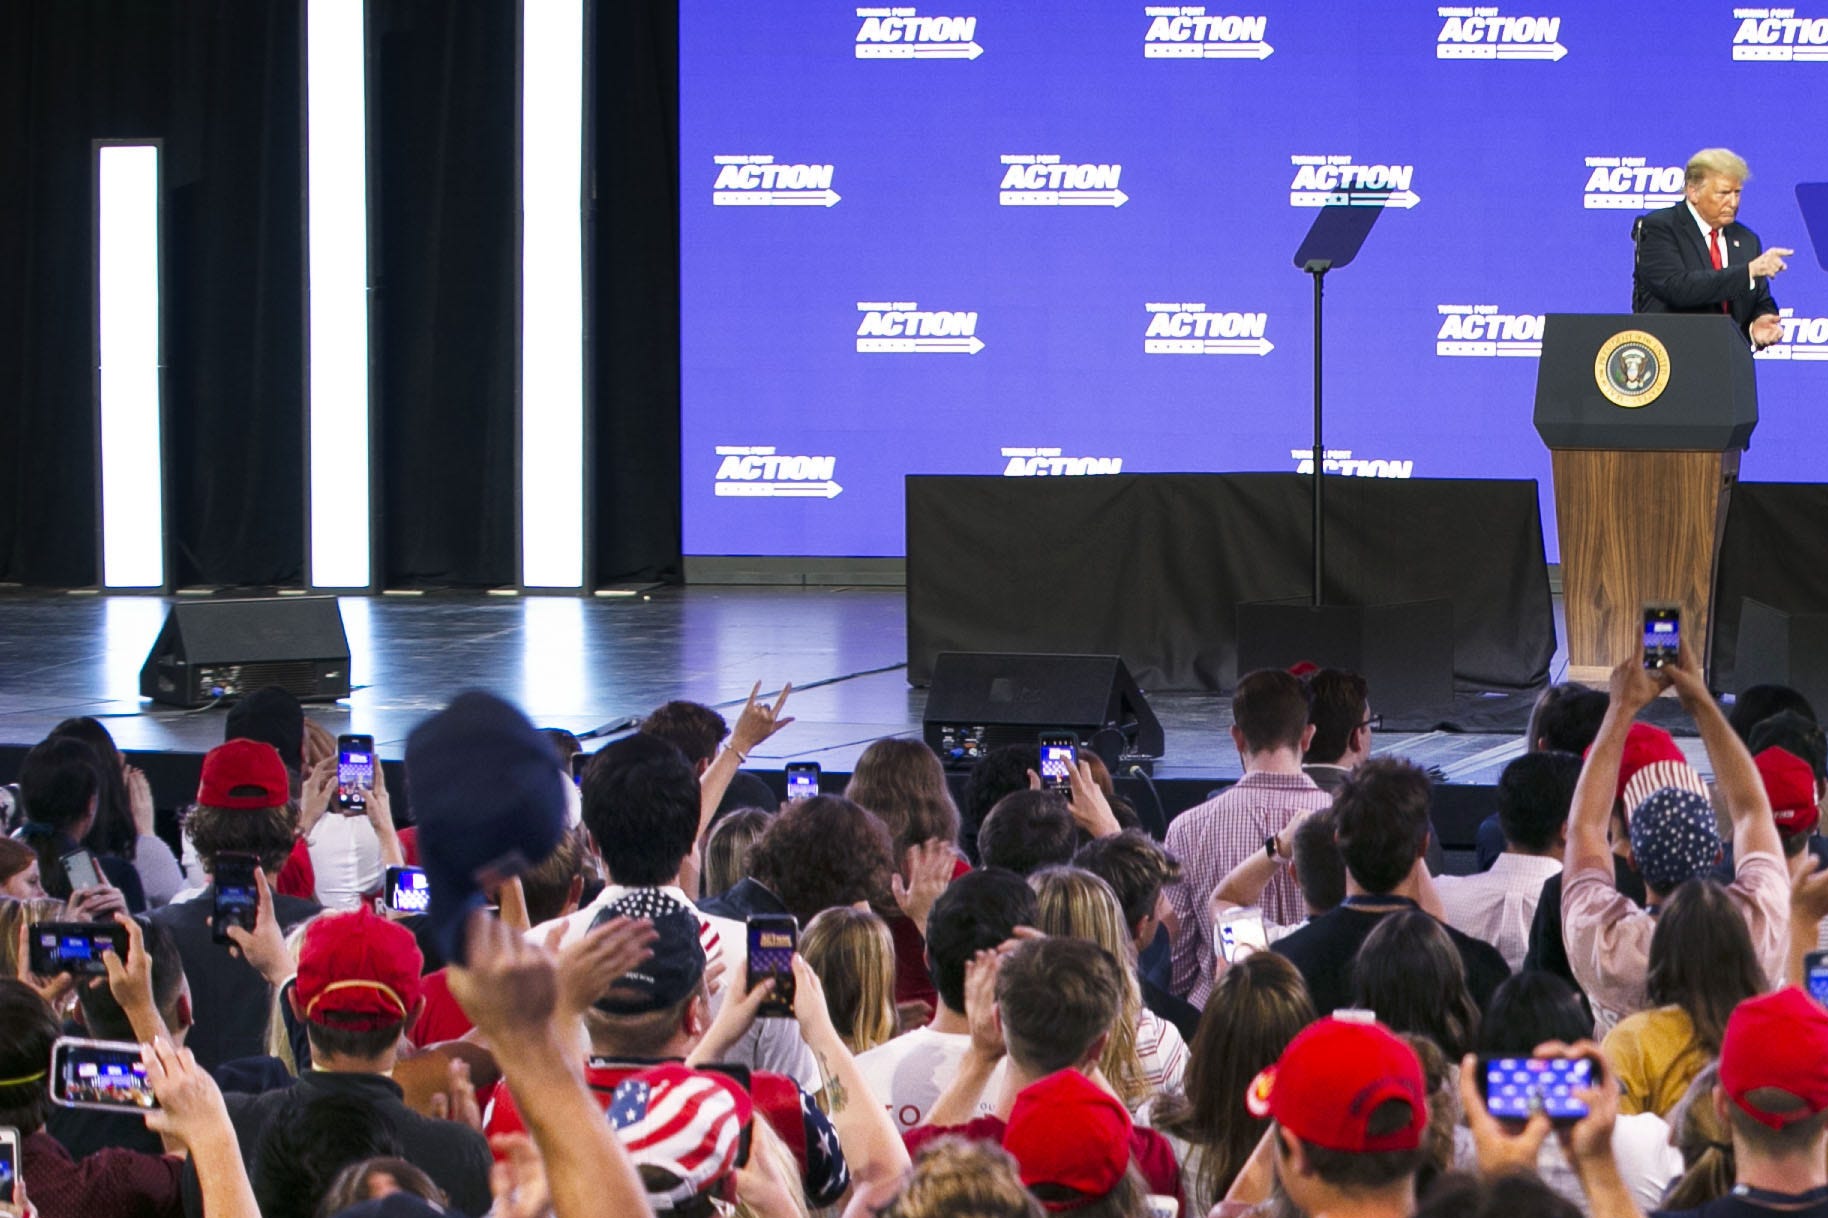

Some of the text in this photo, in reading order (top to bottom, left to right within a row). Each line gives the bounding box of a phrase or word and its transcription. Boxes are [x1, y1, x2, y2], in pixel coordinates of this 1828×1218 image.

[856, 16, 976, 42] ACTION
[1145, 16, 1266, 41] ACTION
[1438, 16, 1560, 42] ACTION
[714, 164, 833, 189] ACTION
[1001, 164, 1121, 189] ACTION
[1292, 165, 1413, 190] ACTION
[1585, 166, 1685, 192] ACTIO
[857, 311, 977, 336] ACTION
[1145, 312, 1267, 337] ACTION
[716, 455, 835, 480] ACTION
[1004, 456, 1122, 476] ACTION
